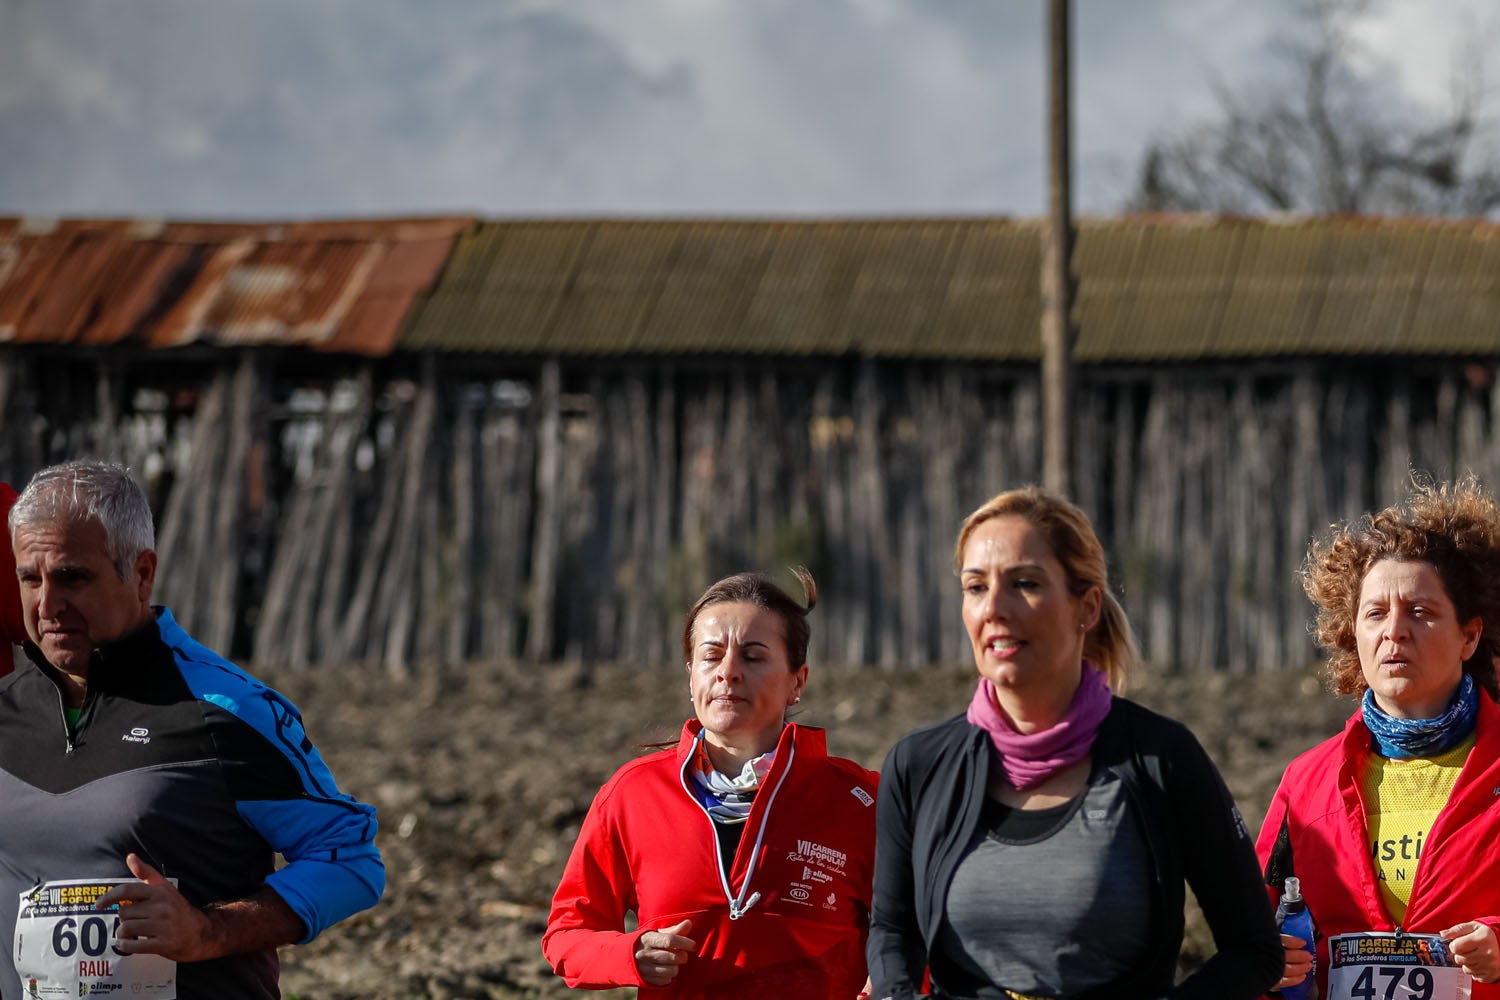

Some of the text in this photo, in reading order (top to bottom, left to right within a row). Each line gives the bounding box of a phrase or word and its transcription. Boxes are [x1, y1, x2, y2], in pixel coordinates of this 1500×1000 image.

[797, 839, 846, 861] VII CARRERA
[810, 850, 846, 867] POPULAR
[50, 888, 60, 906] VII
[793, 890, 806, 898] KIA
[58, 904, 89, 913] Secaderos
[1348, 940, 1359, 955] VII
[1359, 947, 1414, 955] POPULAR
[79, 961, 113, 977] RAUL
[91, 982, 122, 992] olimpo
